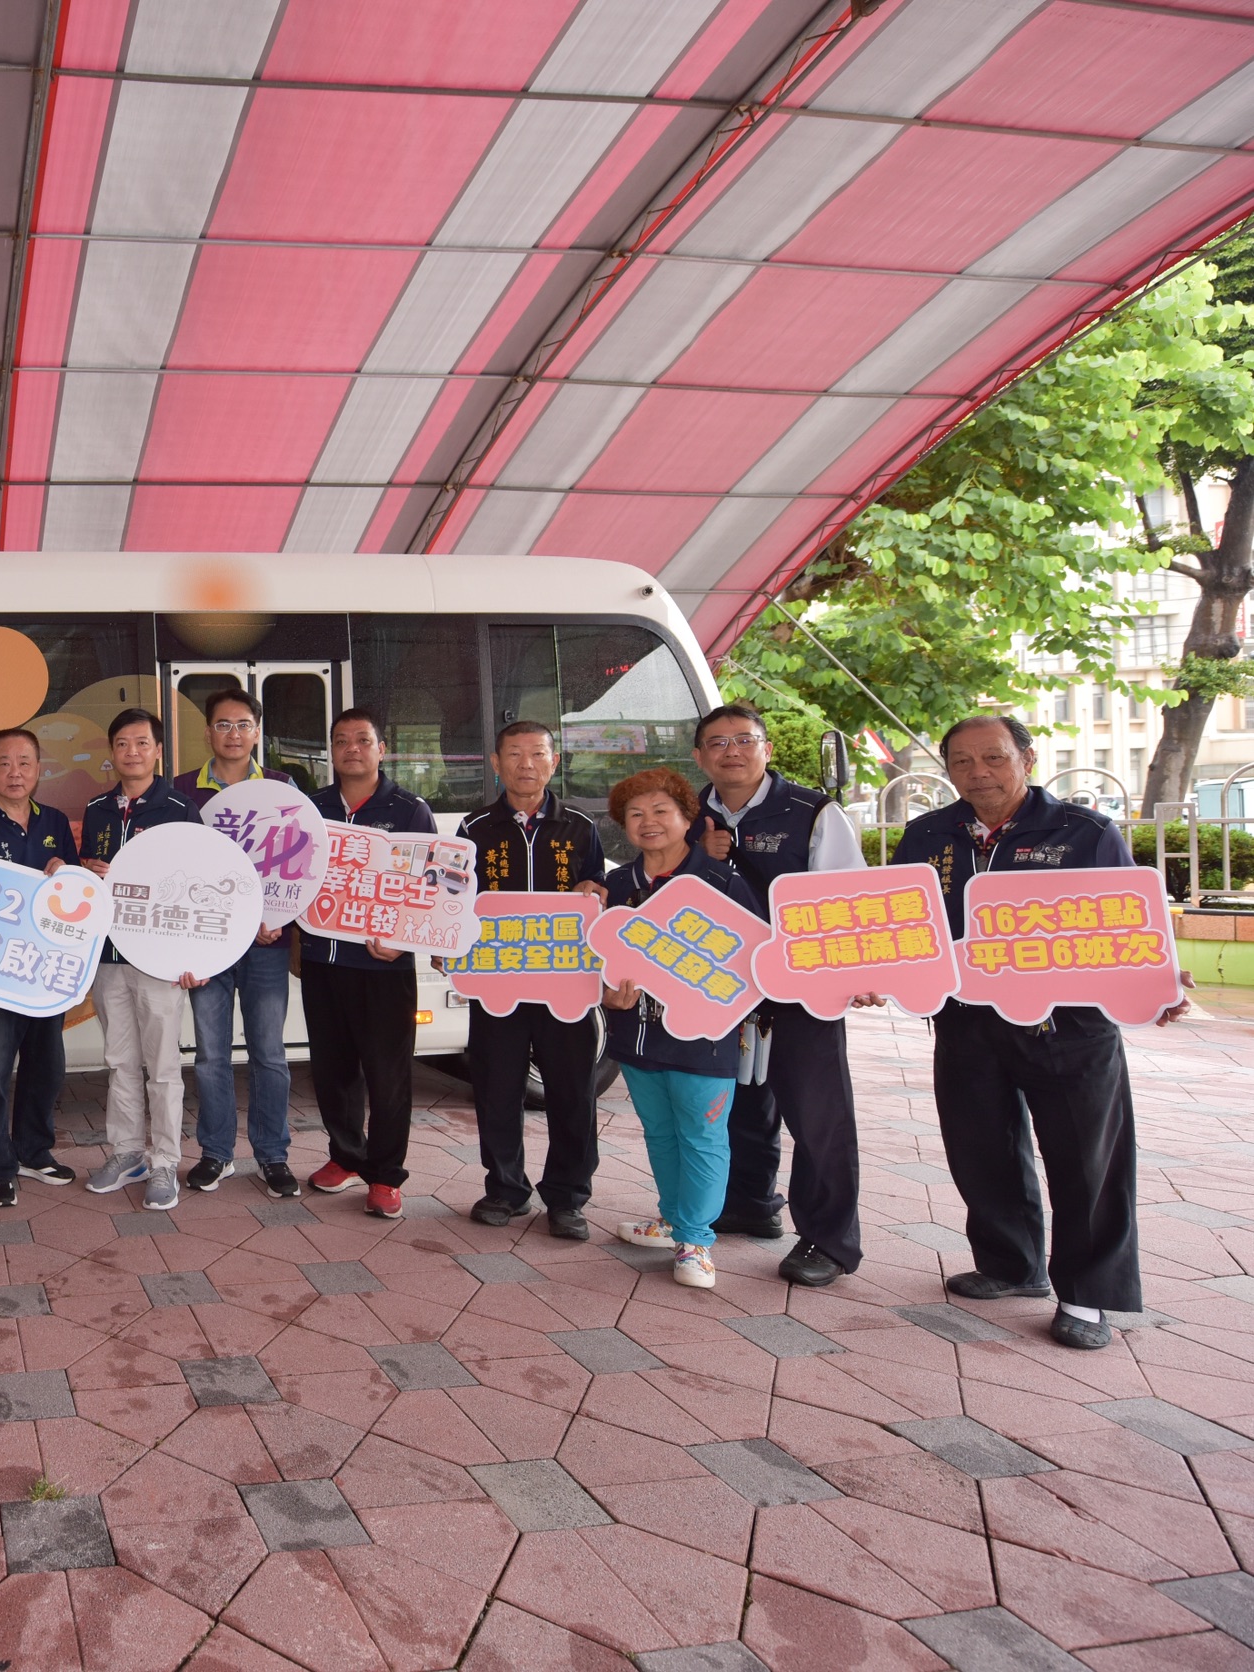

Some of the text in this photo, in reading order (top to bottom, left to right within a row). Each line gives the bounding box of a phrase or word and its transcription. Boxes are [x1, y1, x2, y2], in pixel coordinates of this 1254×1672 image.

[113, 883, 150, 899] 和美
[323, 866, 439, 909] 幸福巴士
[40, 917, 87, 941] 幸福巴士
[336, 901, 399, 938] 出發
[783, 890, 926, 934] 和美有愛
[978, 896, 1143, 935] 16大站點
[672, 911, 738, 960] 和美
[790, 926, 935, 969] 幸福滿載
[971, 933, 1162, 971] 平日6班次
[622, 920, 742, 1001] 幸福發車
